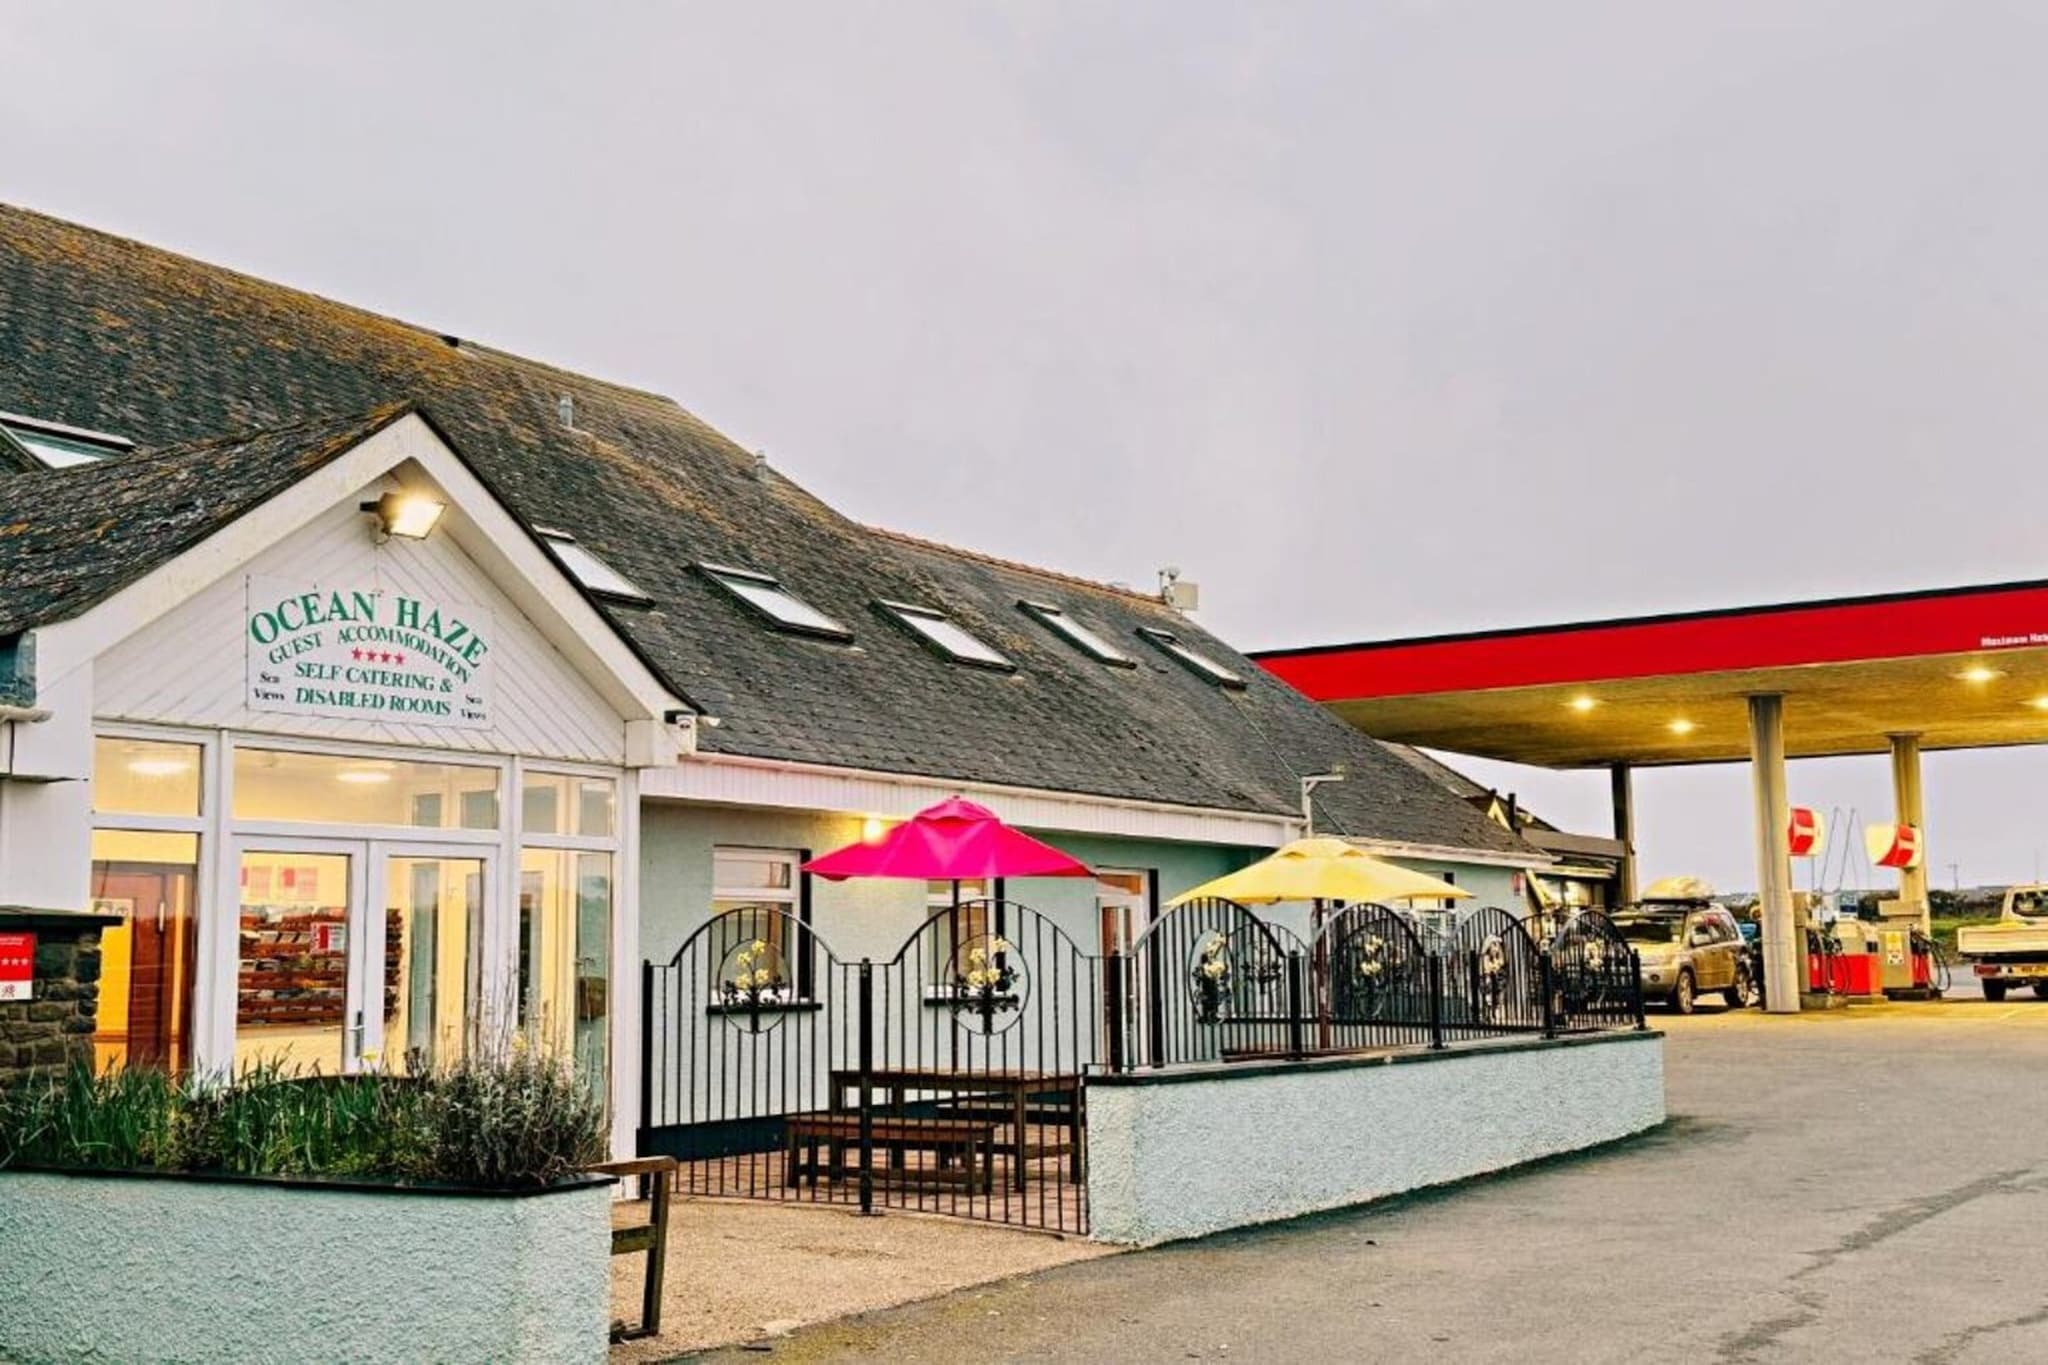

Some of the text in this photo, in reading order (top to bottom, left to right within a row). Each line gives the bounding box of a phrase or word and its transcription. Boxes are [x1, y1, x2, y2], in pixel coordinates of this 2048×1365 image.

[251, 589, 488, 668] OCEAN HAZE
[269, 625, 471, 683] GUEST ACCOMMODATION
[294, 662, 453, 693] SELF CATERING &
[296, 687, 451, 716] DISABLED ROOMS
